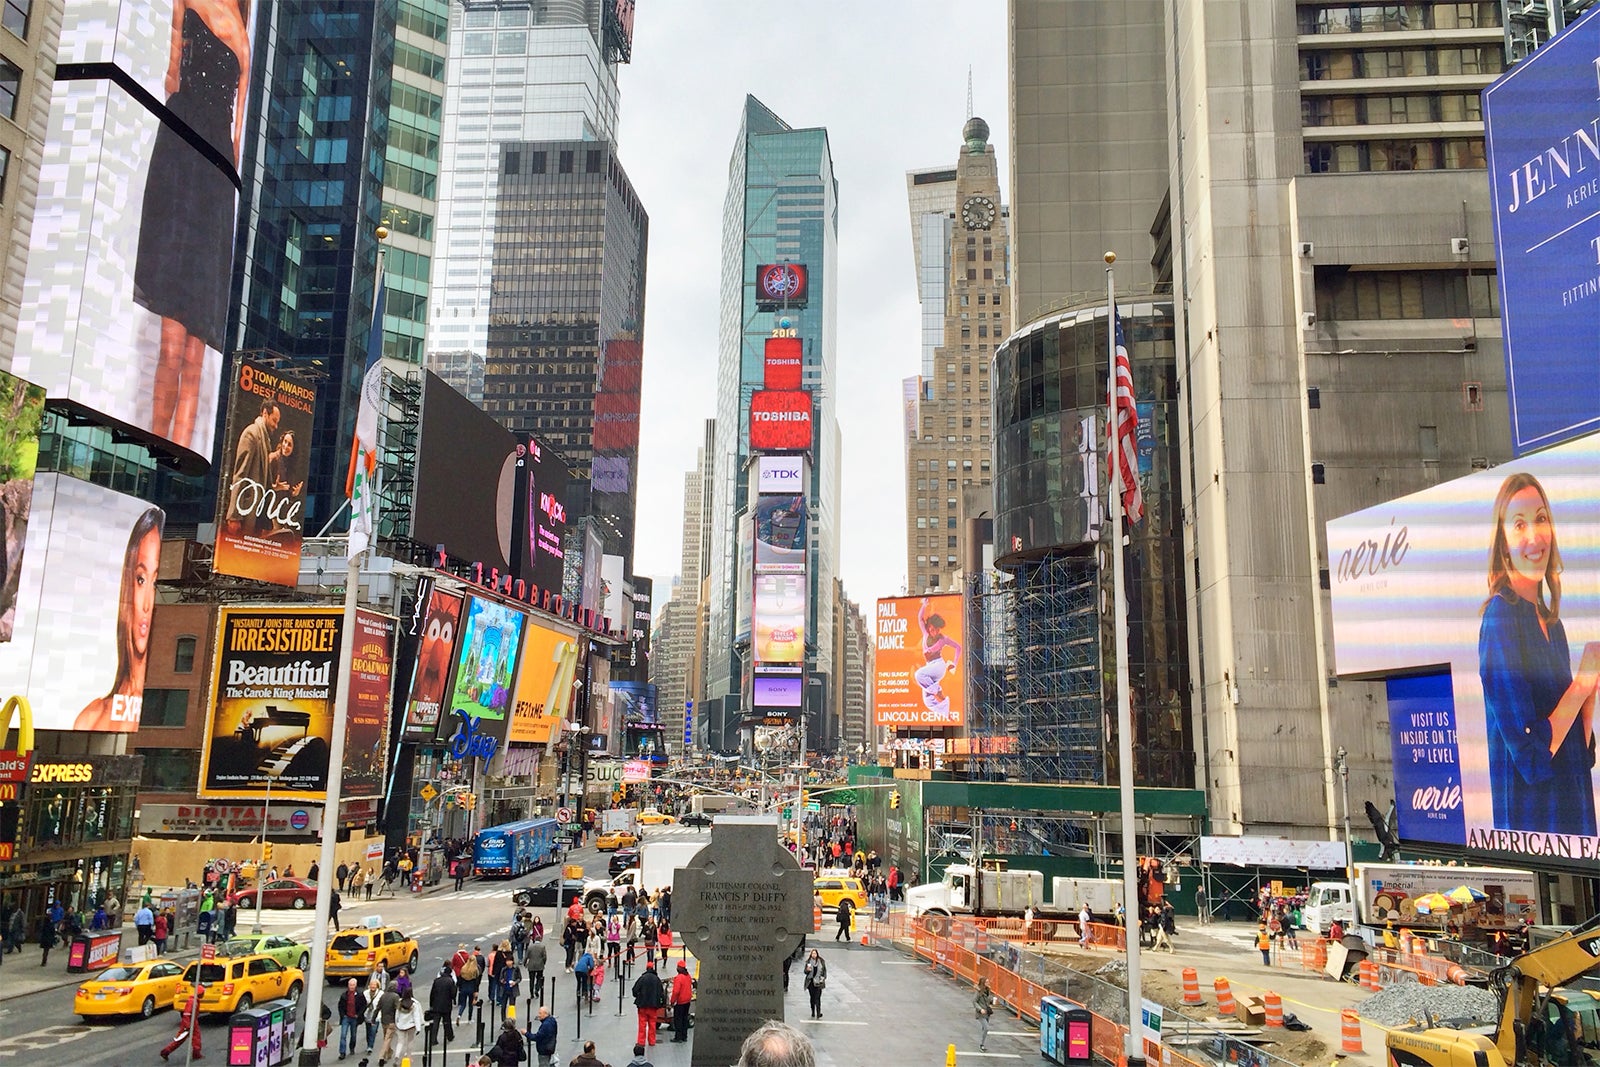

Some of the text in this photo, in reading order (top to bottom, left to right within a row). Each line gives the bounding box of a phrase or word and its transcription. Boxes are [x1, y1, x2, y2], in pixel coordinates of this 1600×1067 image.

[1566, 178, 1598, 208] AERIE
[772, 329, 796, 338] 2014
[239, 365, 315, 400] 8 TONY AWARDS
[253, 384, 313, 415] BEST MUSICAL
[754, 412, 810, 422] TOSHIBA
[771, 470, 799, 478] TDK
[1338, 516, 1409, 584] aerie
[475, 561, 612, 635] 1540 BROADWAY
[878, 603, 897, 617] PAUL
[264, 618, 282, 628] JOINS
[282, 618, 294, 628] THE
[295, 618, 315, 628] RANKS
[316, 618, 324, 628] OF
[324, 618, 336, 628] THE
[878, 619, 908, 634] TAYLOR
[878, 635, 904, 650] DANCE
[227, 659, 332, 686] Beautiful
[352, 658, 390, 675] BROADWAY
[226, 687, 328, 700] The Carole King Musical
[412, 700, 440, 715] UPPETS
[878, 712, 918, 722] LINCOLN
[1411, 712, 1449, 727] VISIT US
[1400, 731, 1428, 745] INSIDE
[1432, 730, 1444, 744] ON
[1412, 748, 1454, 763] 3RD LEVEL
[31, 764, 93, 782] EXPRESS
[1412, 777, 1462, 810] aerie
[178, 806, 272, 818] DIGITAL
[1468, 827, 1570, 858] AMERICAN
[706, 882, 746, 890] LIEUTENANT
[1384, 881, 1414, 889] Imperial
[700, 892, 740, 901] FRANCIS
[754, 892, 787, 902] DUFFY
[1406, 1037, 1441, 1052] CONSTRUCTION
